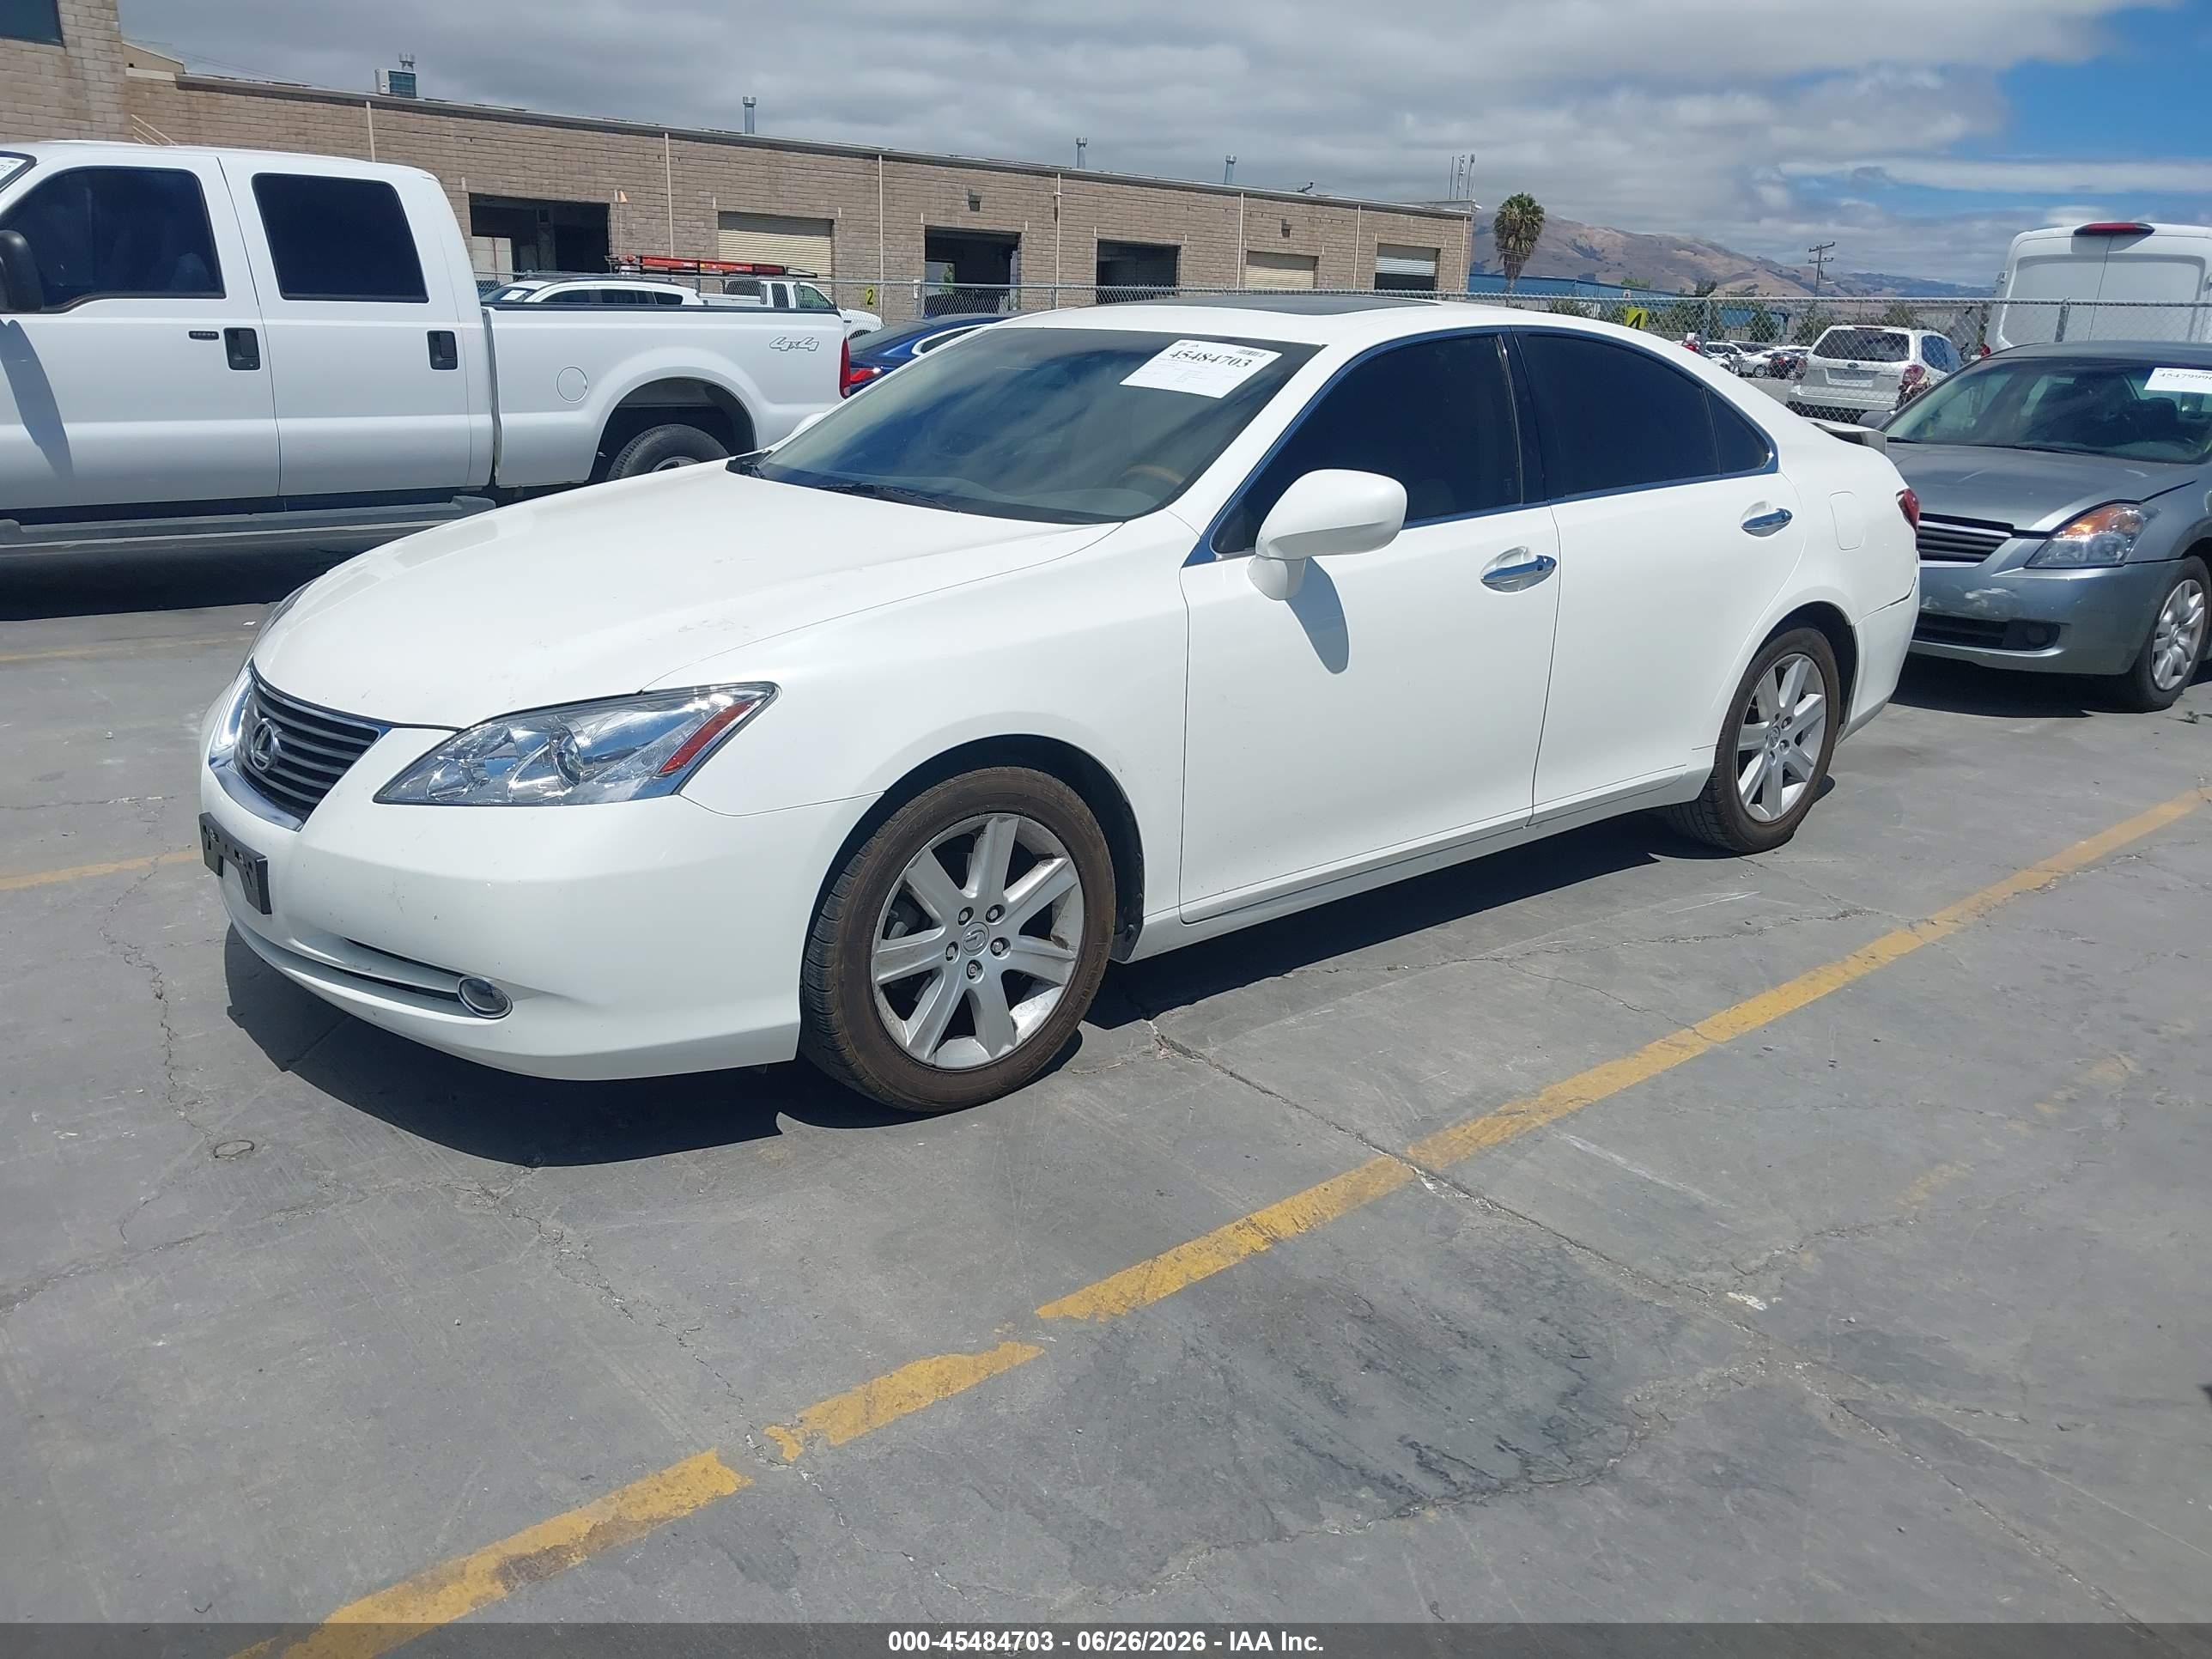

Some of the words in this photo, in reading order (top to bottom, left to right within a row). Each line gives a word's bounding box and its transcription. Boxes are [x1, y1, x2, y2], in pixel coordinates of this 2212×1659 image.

[866, 289, 873, 306] 2
[769, 336, 819, 351] 4x4
[1170, 349, 1253, 368] 45484703
